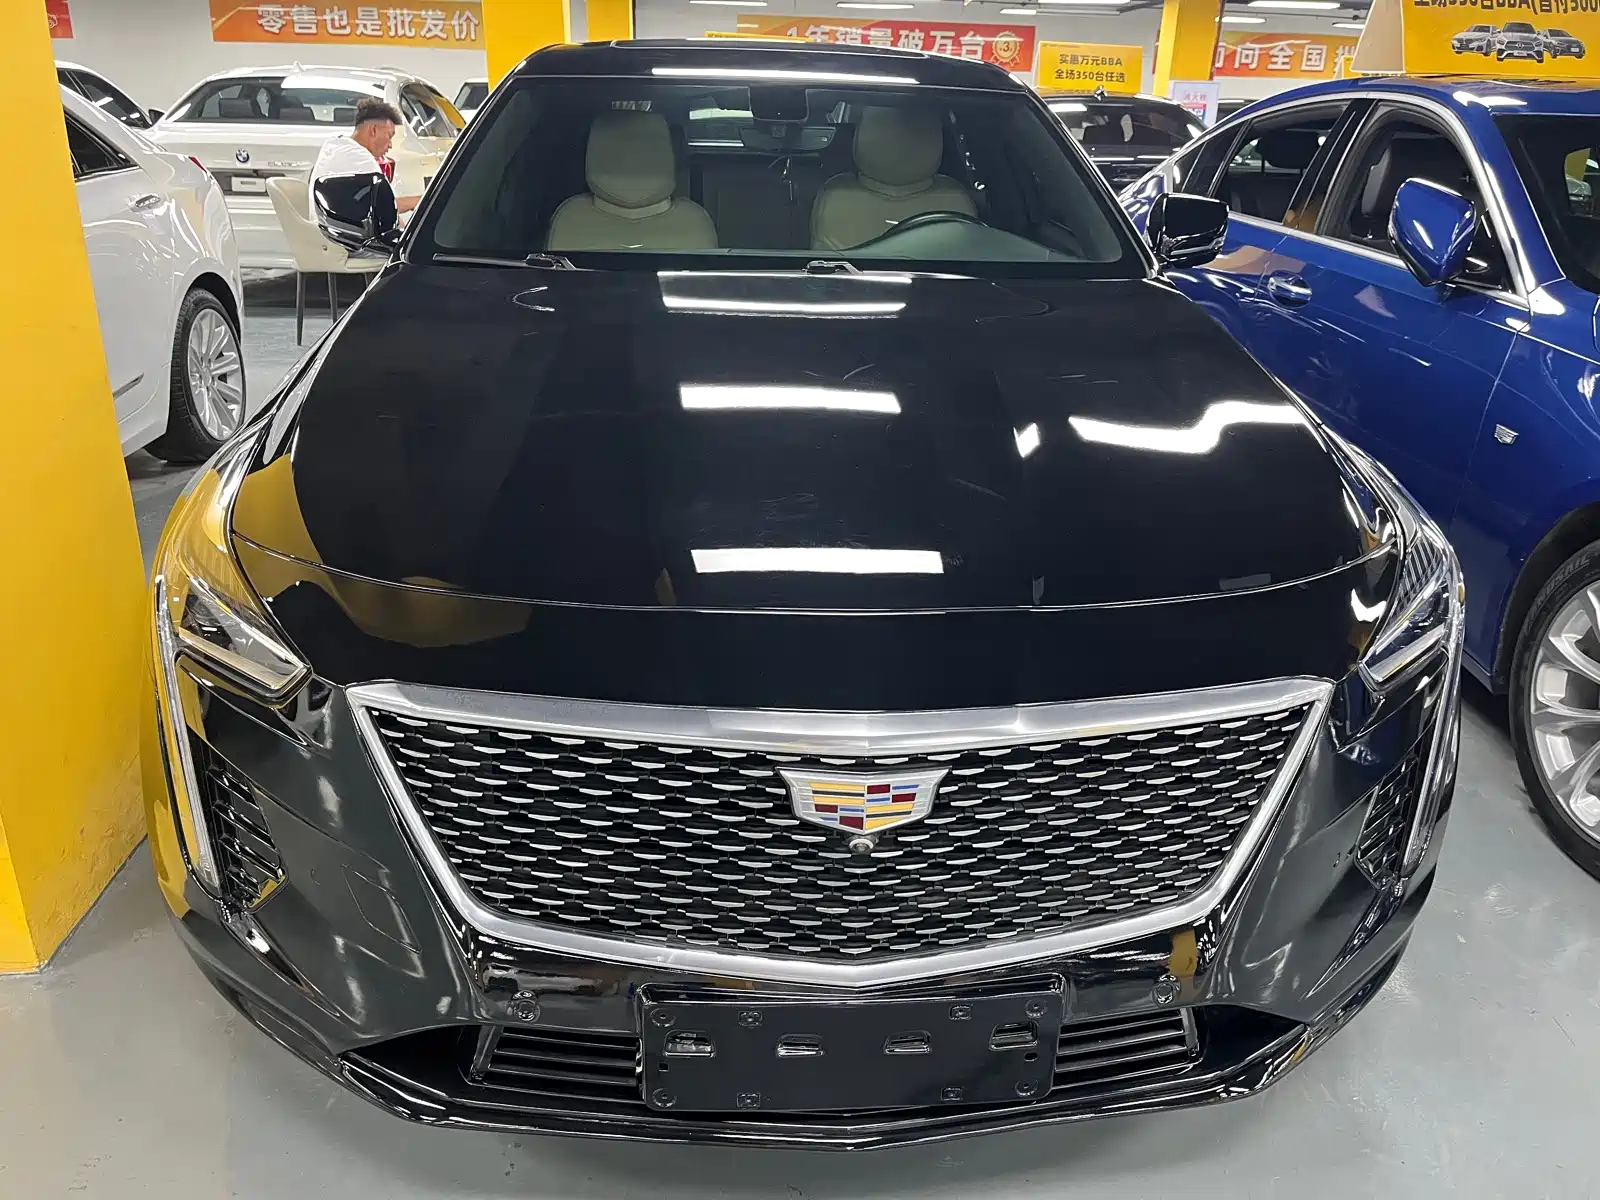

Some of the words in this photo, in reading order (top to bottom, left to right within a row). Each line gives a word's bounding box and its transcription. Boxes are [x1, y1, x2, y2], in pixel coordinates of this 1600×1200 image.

[257, 3, 480, 41] 零售也是批发价
[1059, 53, 1123, 67] 实惠万元BBA
[1214, 42, 1356, 73] 向全国
[1054, 68, 1126, 83] 全场350台任选
